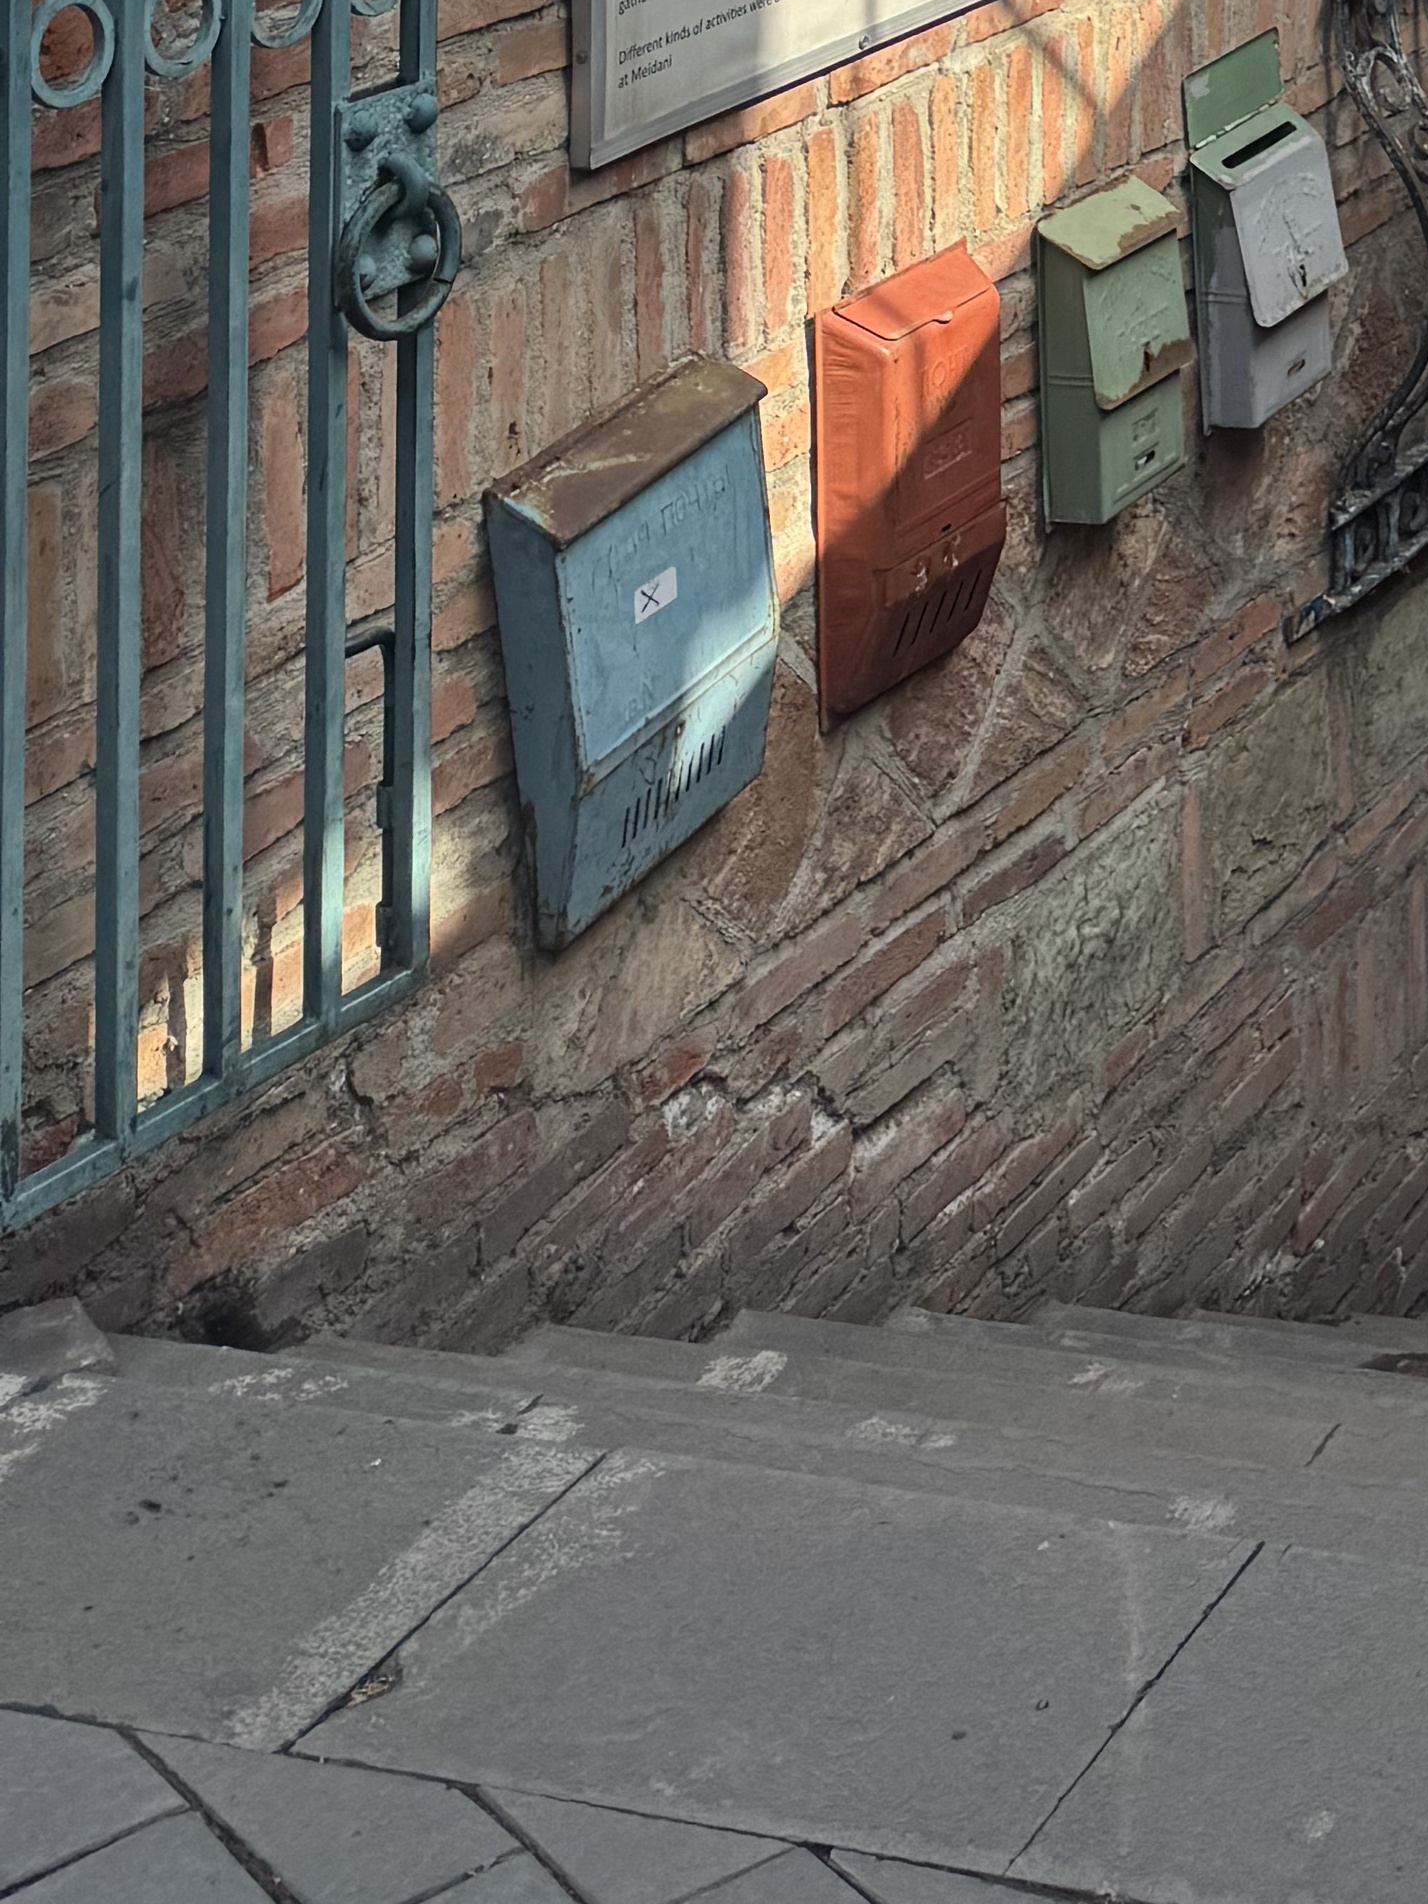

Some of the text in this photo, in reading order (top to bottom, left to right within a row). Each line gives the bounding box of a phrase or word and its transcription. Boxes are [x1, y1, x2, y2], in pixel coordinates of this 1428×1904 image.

[618, 36, 663, 66] Different
[665, 25, 692, 46] kinds
[692, 18, 704, 36] of
[705, 4, 748, 31] activities
[617, 53, 672, 89] at Meidani
